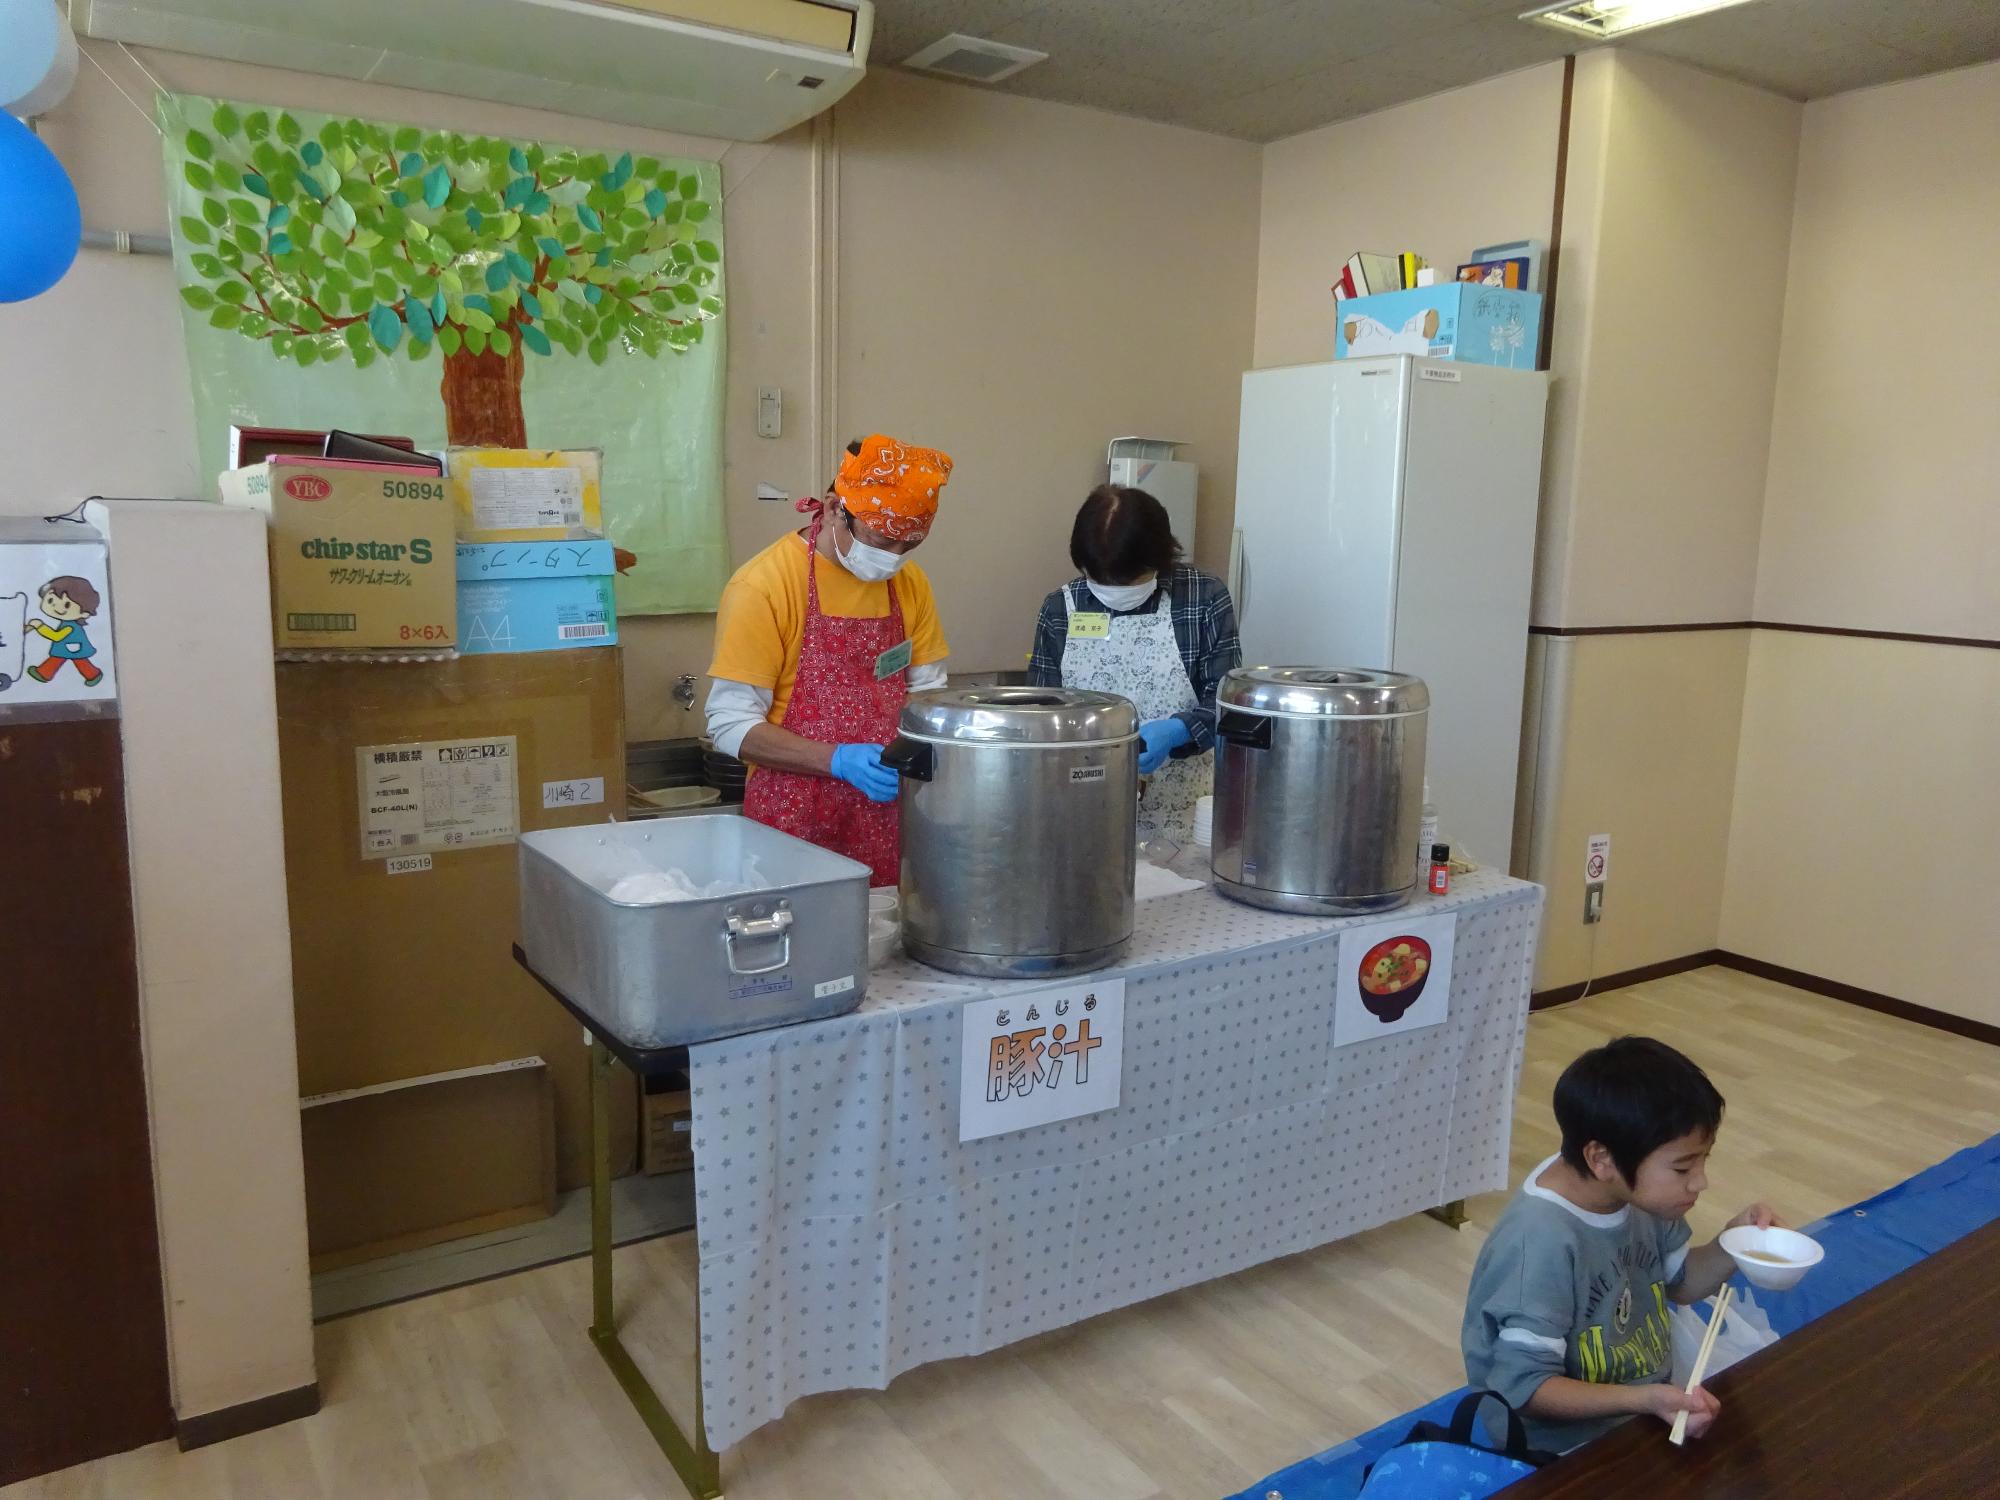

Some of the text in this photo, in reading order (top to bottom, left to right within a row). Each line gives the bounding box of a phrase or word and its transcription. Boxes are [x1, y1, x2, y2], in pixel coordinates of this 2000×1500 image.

[292, 479, 323, 497] YBC
[383, 480, 444, 501] 50894
[410, 538, 433, 564] S
[465, 614, 516, 651] A4
[389, 857, 431, 871] 130519
[995, 993, 1097, 1027] とんじる
[986, 1018, 1102, 1102] 豚汁
